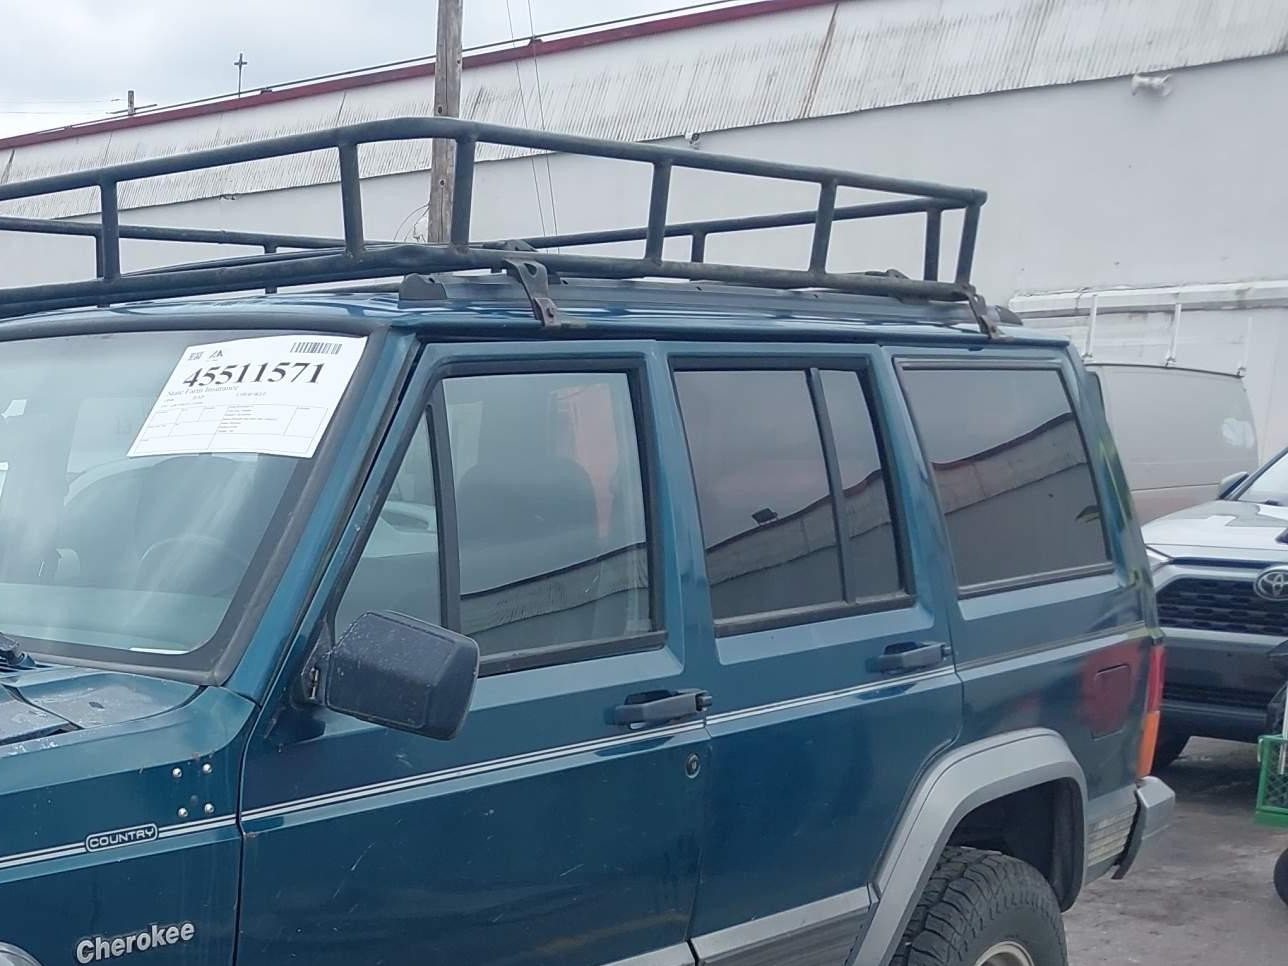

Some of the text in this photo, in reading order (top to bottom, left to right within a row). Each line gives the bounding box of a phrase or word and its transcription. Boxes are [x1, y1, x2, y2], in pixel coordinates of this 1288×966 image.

[183, 362, 325, 387] 45511571
[89, 828, 154, 848] COUNTRY
[76, 921, 196, 964] Cherokee
